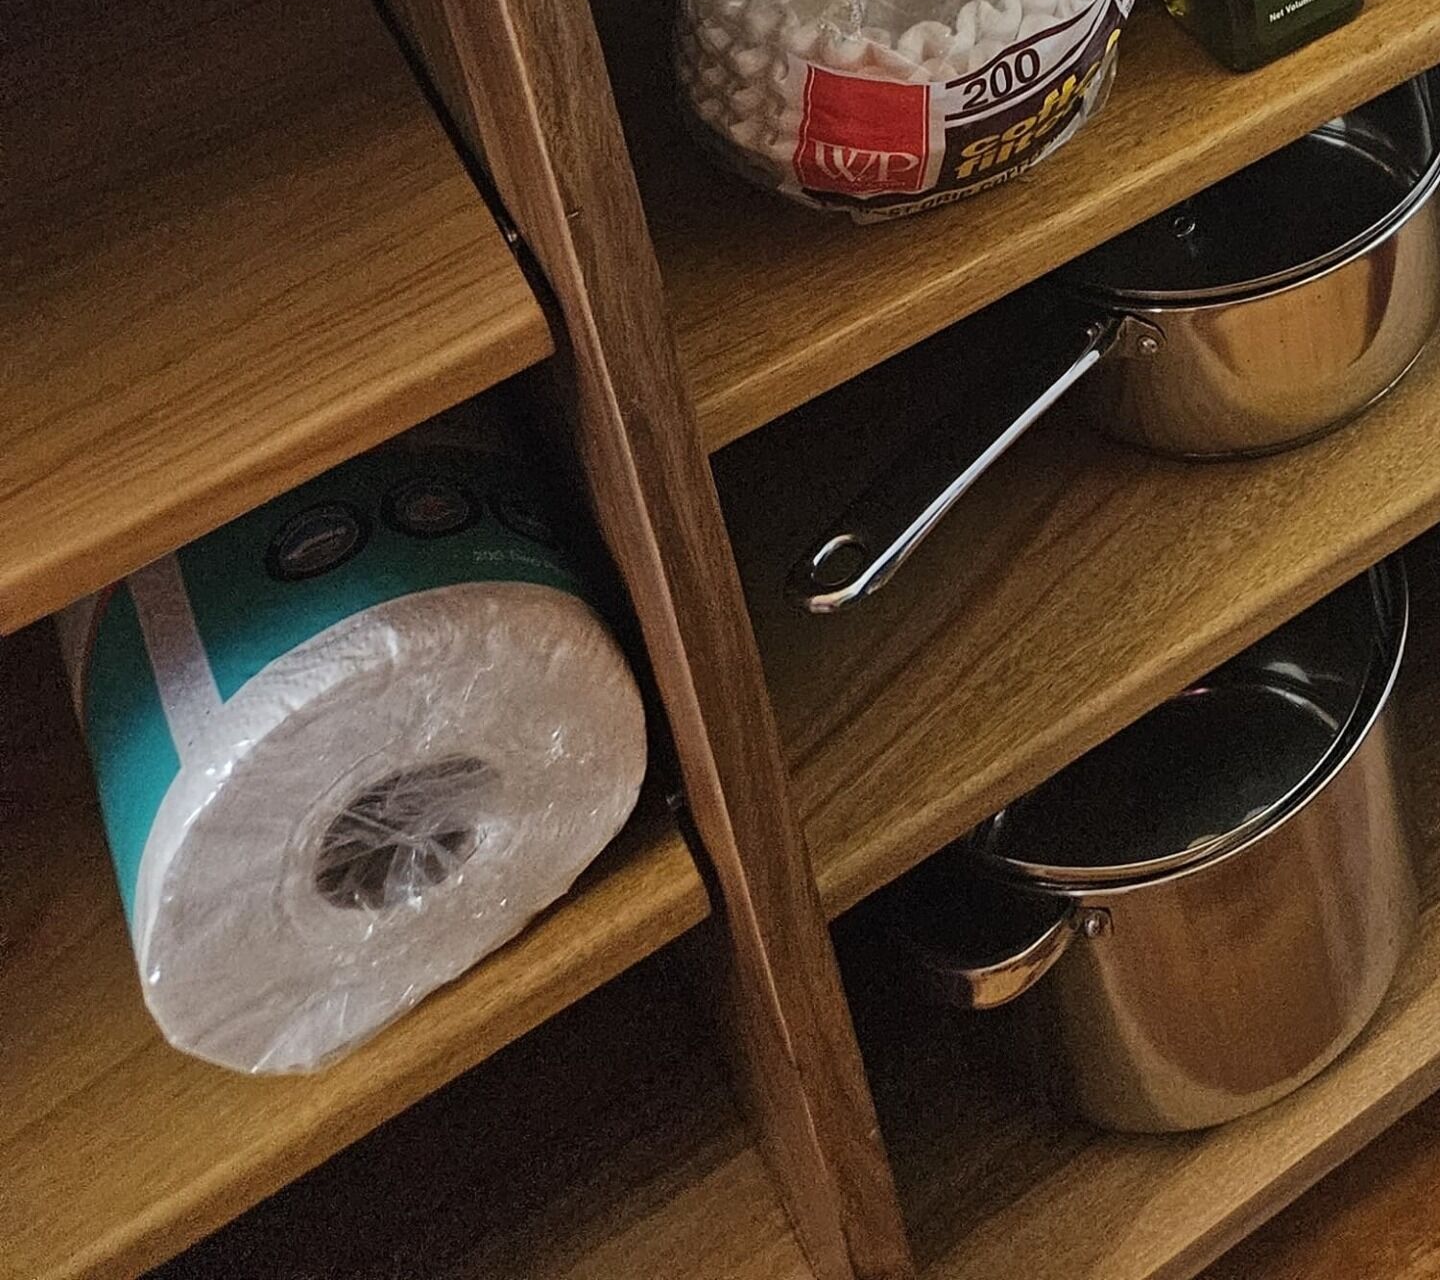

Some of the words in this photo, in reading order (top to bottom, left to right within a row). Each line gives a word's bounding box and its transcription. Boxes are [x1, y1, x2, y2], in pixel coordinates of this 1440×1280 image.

[1269, 8, 1285, 22] Net
[962, 48, 1041, 110] 200
[809, 138, 920, 182] WP
